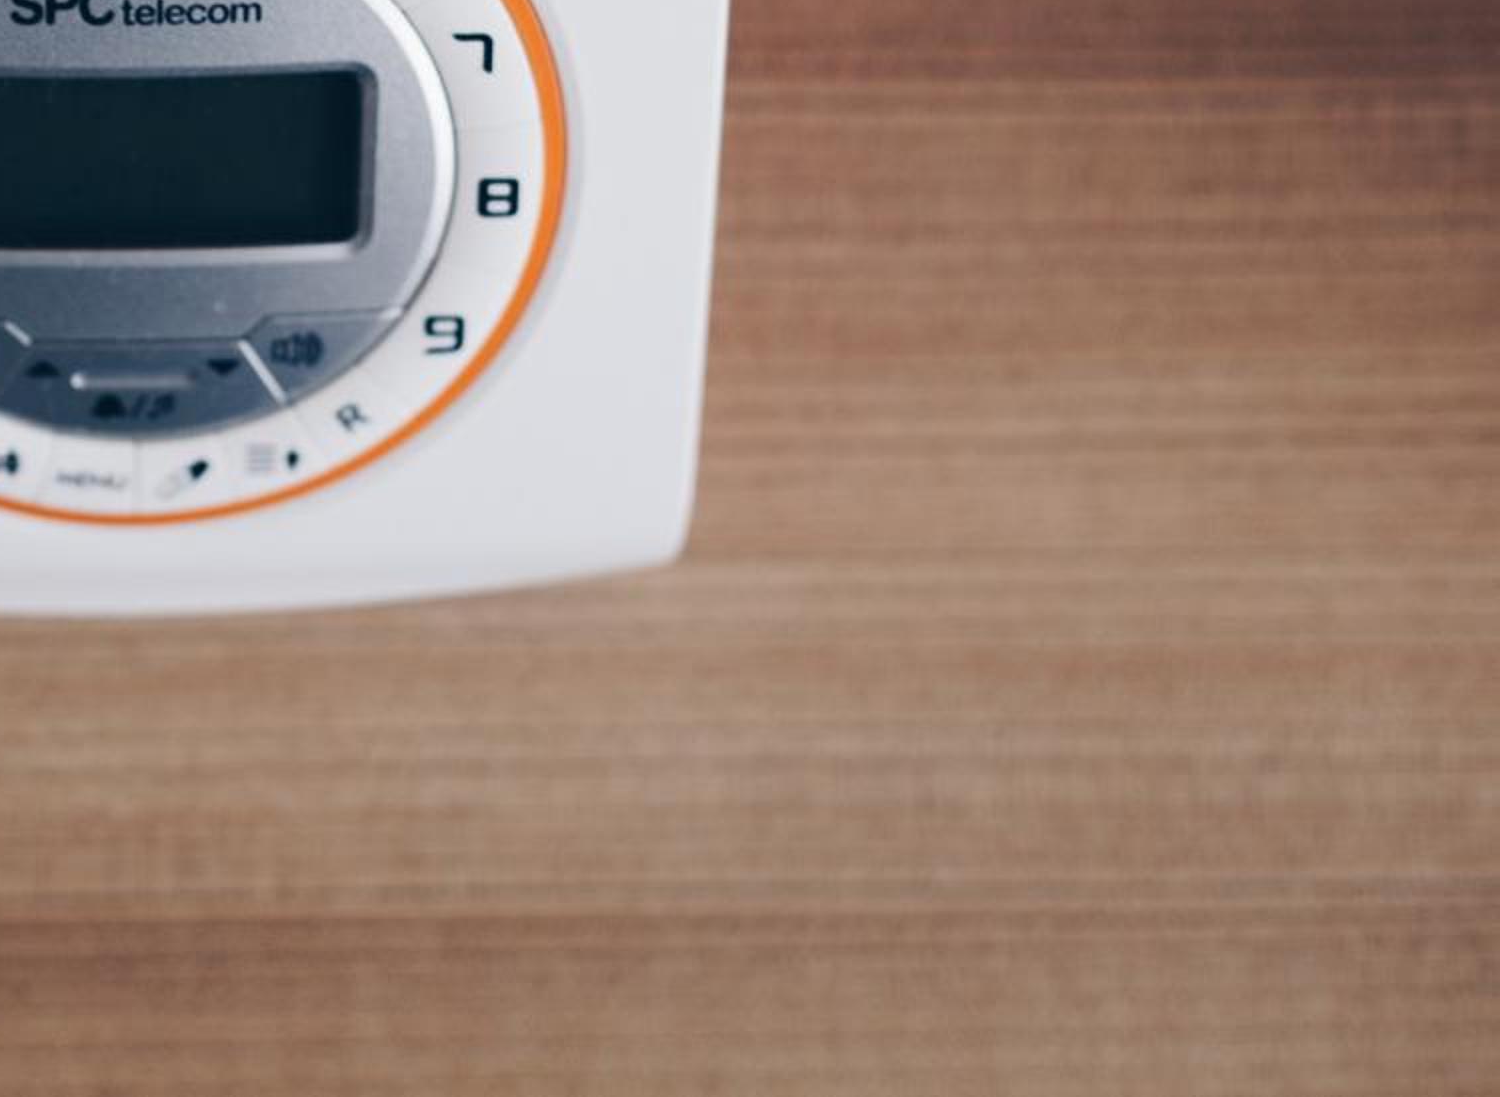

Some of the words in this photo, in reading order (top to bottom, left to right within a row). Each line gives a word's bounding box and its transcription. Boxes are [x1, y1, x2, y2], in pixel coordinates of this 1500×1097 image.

[453, 33, 494, 74] 7
[477, 178, 520, 218] 8
[424, 315, 465, 354] 9
[336, 403, 368, 433] R
